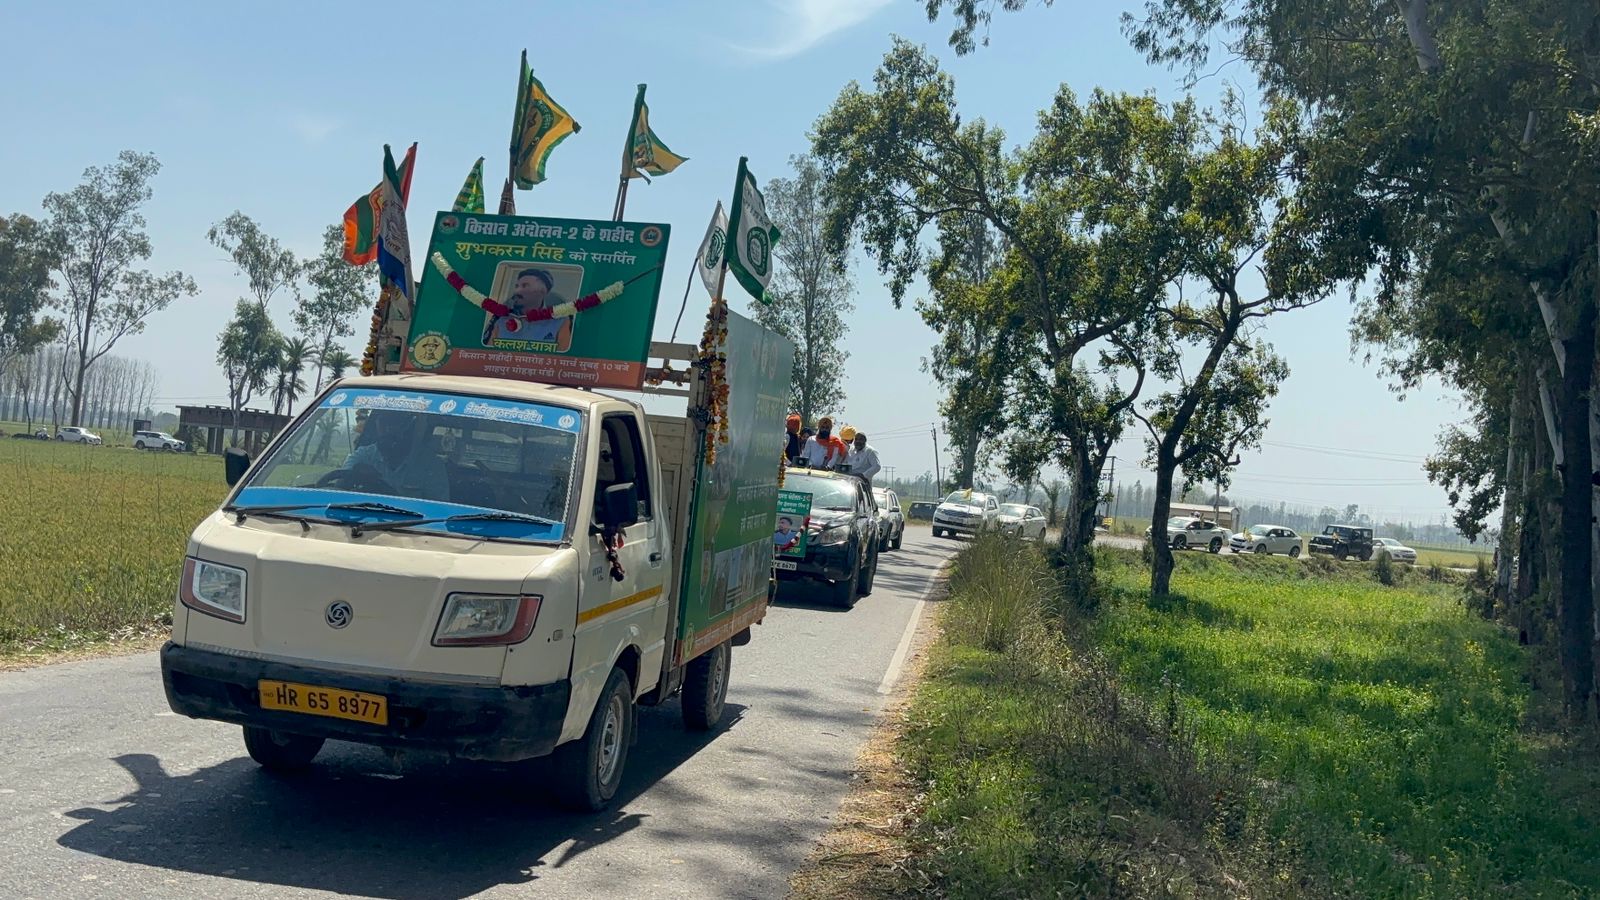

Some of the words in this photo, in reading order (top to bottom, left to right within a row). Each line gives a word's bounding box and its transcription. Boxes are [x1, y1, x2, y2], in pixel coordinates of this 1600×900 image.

[464, 218, 508, 235] किसान
[582, 224, 596, 240] के
[599, 225, 635, 243] शहीद
[455, 241, 528, 260] शुभकरन
[532, 241, 565, 261] सिंह
[568, 248, 588, 261] को
[591, 250, 637, 265] समर्पित
[493, 338, 527, 351] कलश
[529, 341, 558, 353] यात्रा
[459, 350, 486, 360] किसान
[545, 357, 557, 366] 31
[559, 357, 577, 368] मार्च
[602, 362, 612, 371] 10
[276, 686, 298, 707] HR
[307, 692, 329, 710] 65
[338, 696, 380, 718] 8977
